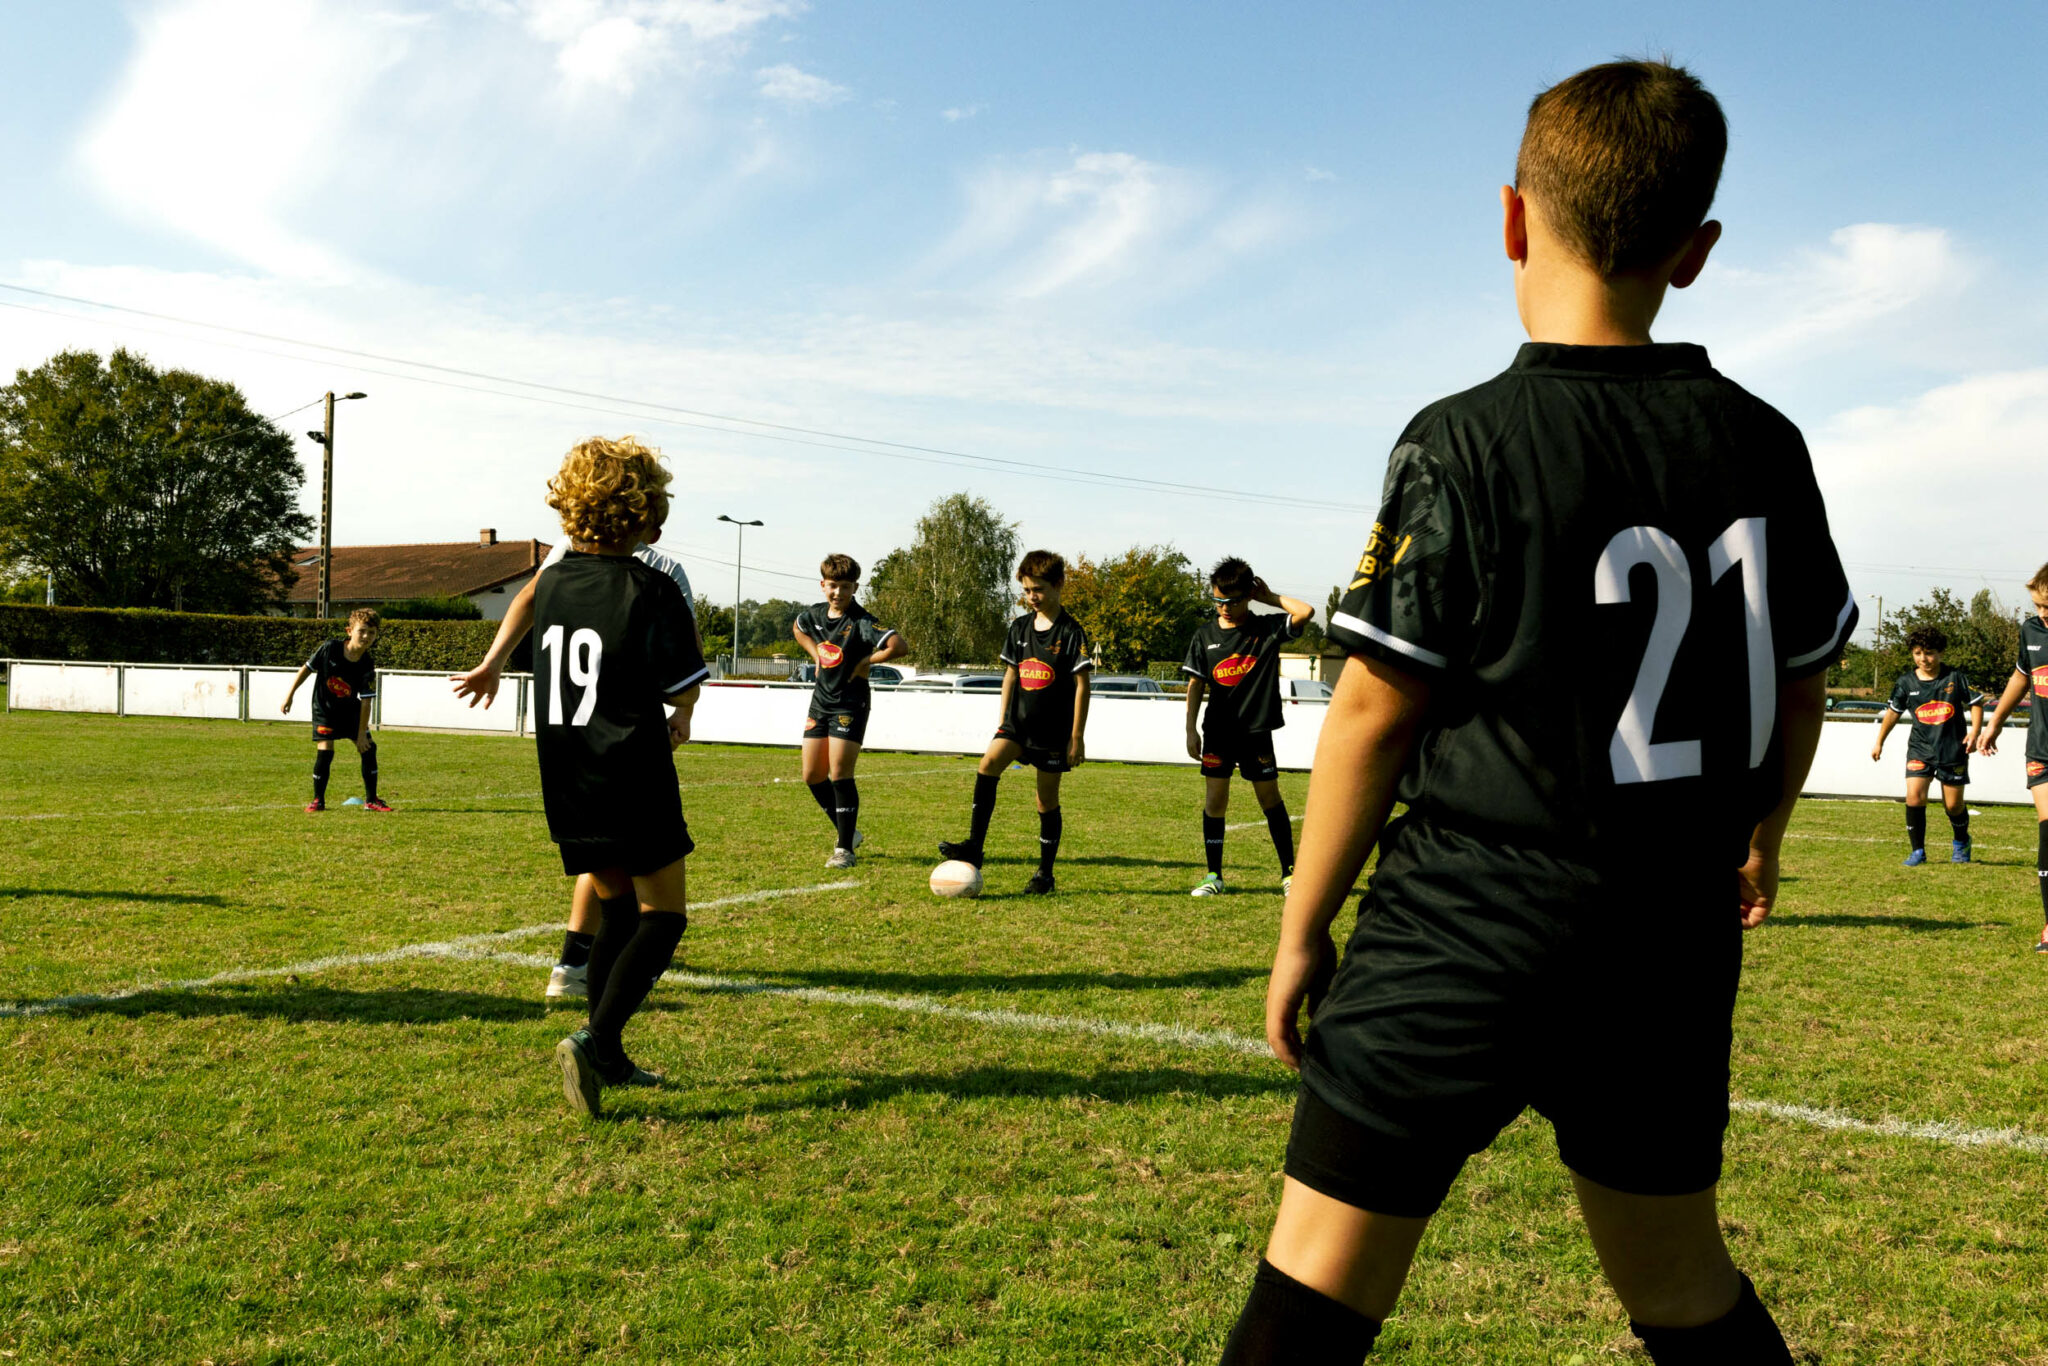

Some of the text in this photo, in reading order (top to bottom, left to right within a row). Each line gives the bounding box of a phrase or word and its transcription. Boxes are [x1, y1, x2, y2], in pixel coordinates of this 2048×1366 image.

[541, 624, 603, 727] 19
[1595, 517, 1777, 785] 21
[1917, 706, 1952, 719] BIGARD
